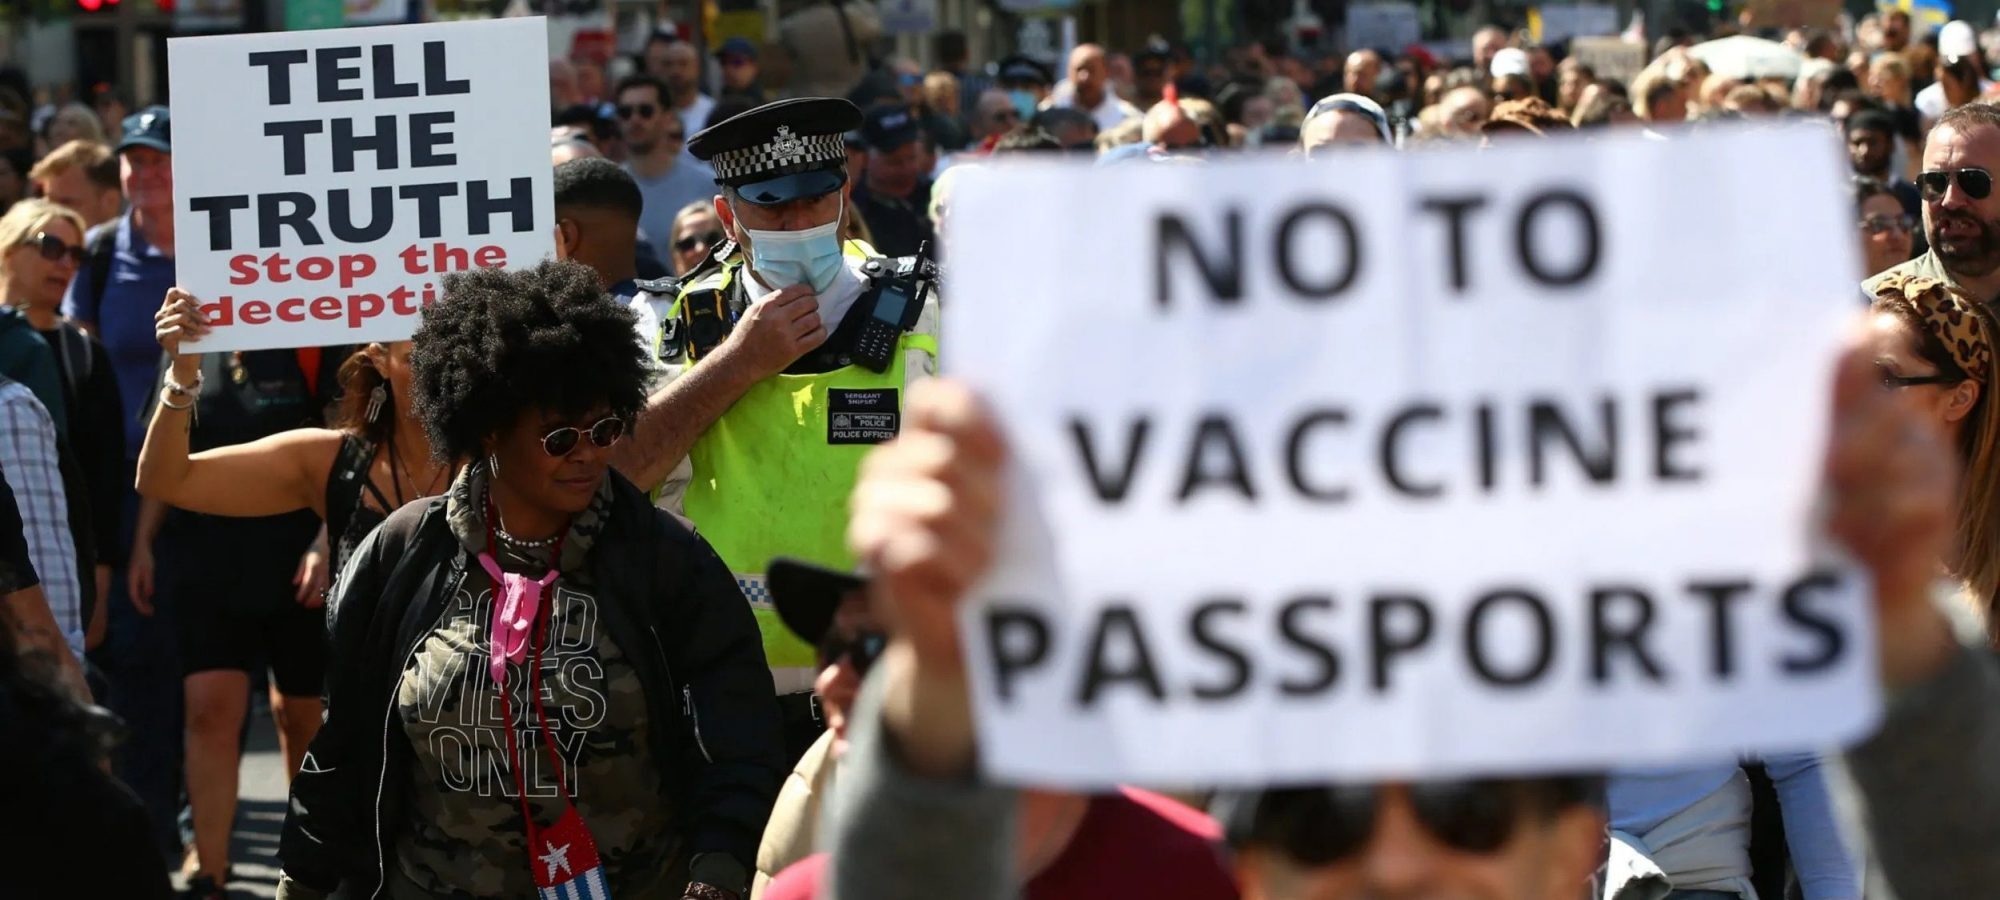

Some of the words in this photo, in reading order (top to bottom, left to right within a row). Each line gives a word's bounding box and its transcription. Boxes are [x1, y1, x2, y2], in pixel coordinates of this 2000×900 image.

[249, 40, 470, 105] TELL
[264, 111, 457, 176] THE
[190, 176, 535, 251] TRUTH
[1154, 201, 1365, 309] NO
[1414, 188, 1606, 291] TO
[229, 252, 377, 288] Stop
[398, 242, 508, 274] the
[199, 282, 437, 328] decepti
[833, 430, 860, 438] POLICE
[862, 431, 894, 439] OFFICER
[1068, 389, 1708, 505] VACCINE
[982, 569, 1850, 708] PASSPORTS
[415, 652, 607, 730] VIBES
[429, 726, 588, 798] ONLY
